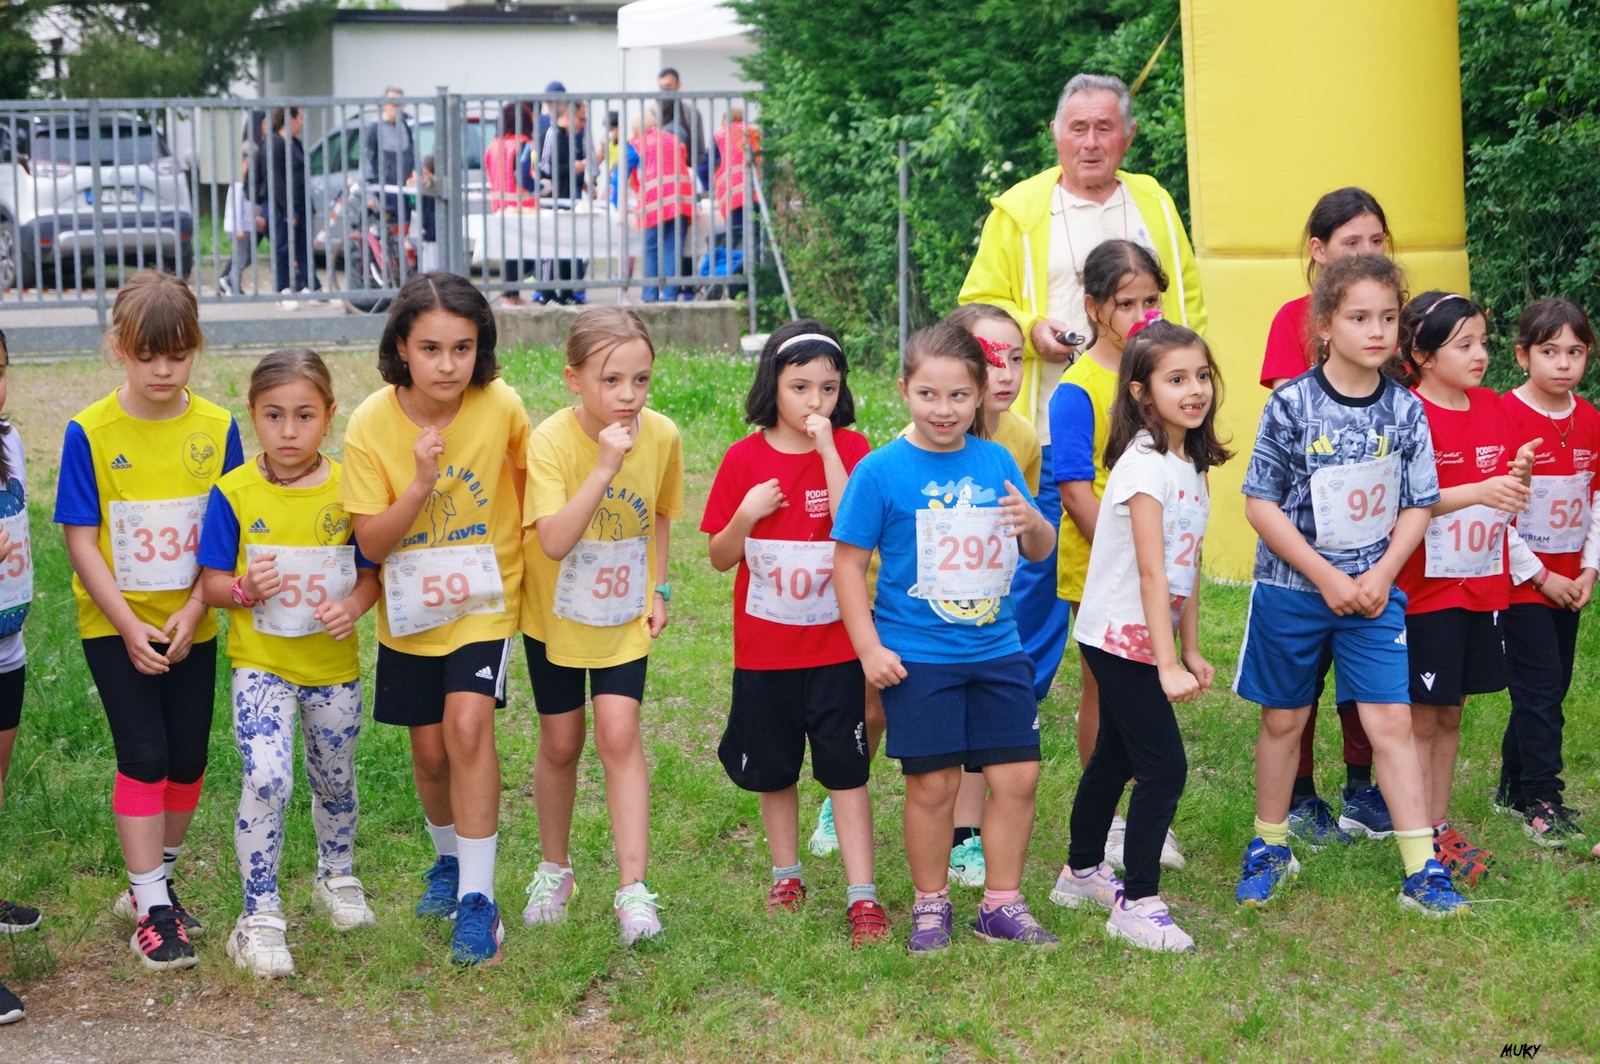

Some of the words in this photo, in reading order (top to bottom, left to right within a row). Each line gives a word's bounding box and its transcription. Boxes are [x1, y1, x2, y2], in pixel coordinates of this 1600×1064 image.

[1347, 484, 1386, 521] 92
[1549, 498, 1583, 529] 52
[133, 523, 199, 563] 334
[938, 534, 1004, 571] 292
[1447, 519, 1504, 553] 106
[0, 536, 31, 581] 53
[279, 574, 328, 609] 55
[422, 572, 471, 608] 59
[592, 565, 630, 600] 58
[768, 566, 835, 601] 107
